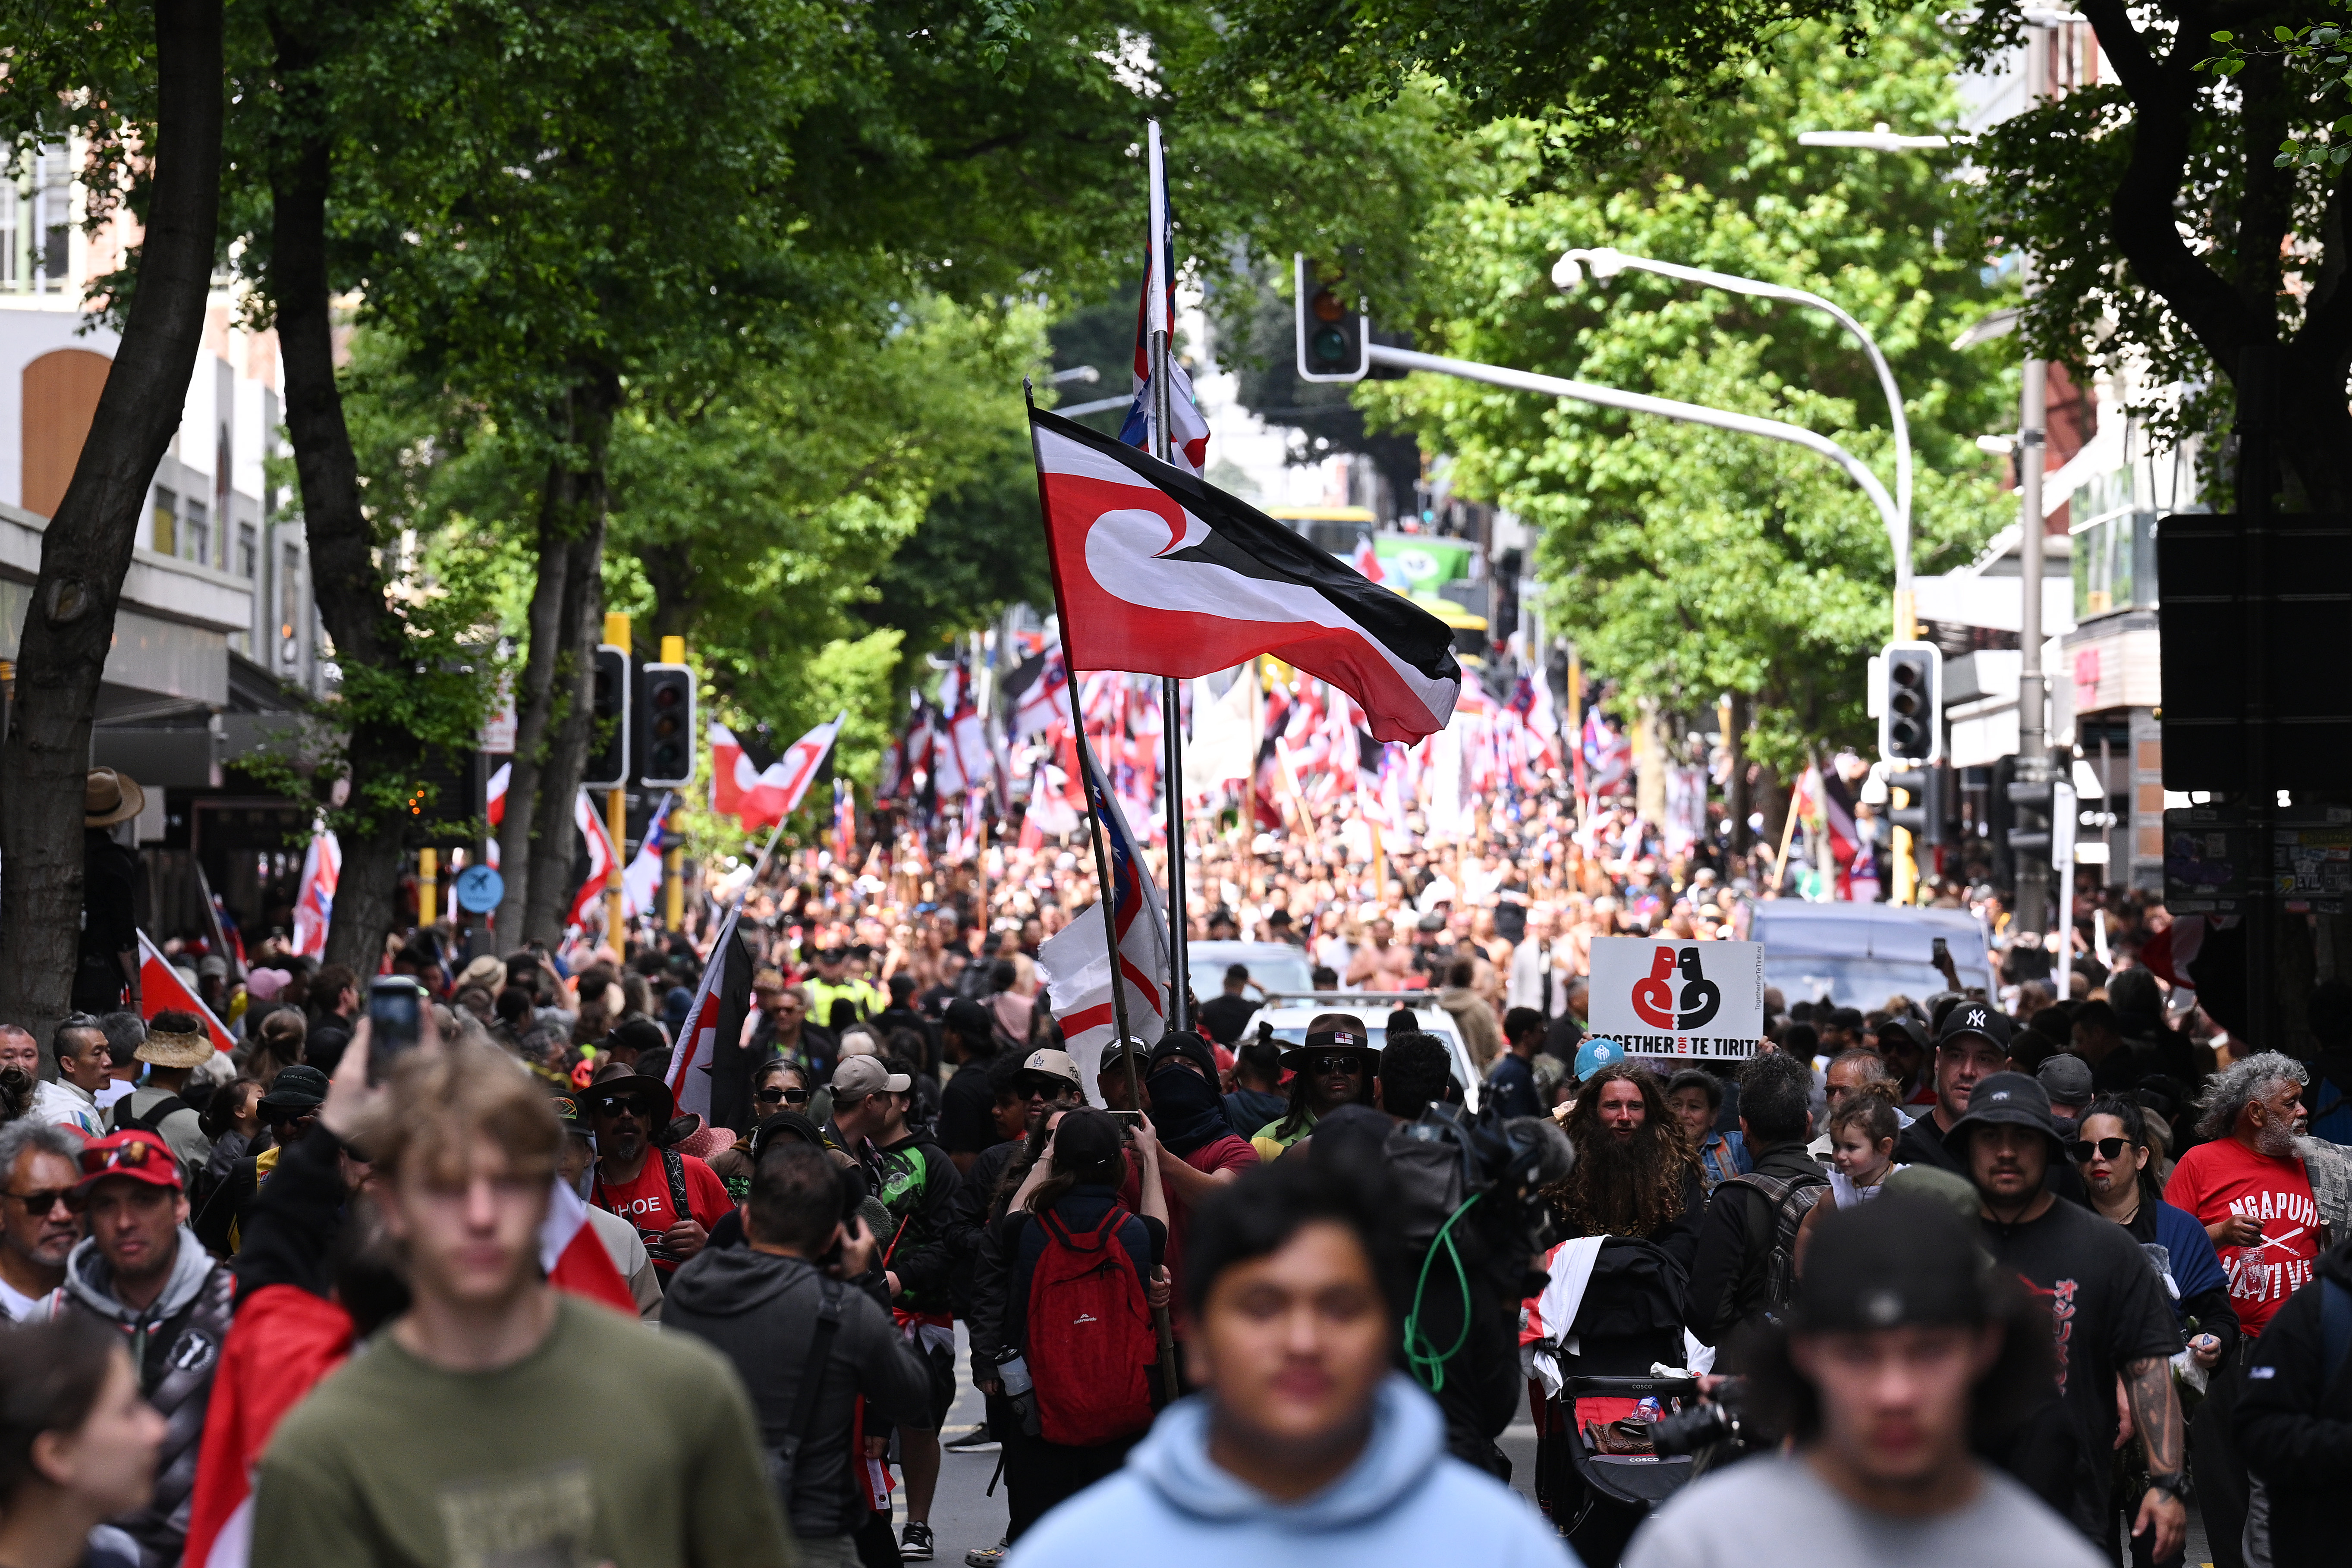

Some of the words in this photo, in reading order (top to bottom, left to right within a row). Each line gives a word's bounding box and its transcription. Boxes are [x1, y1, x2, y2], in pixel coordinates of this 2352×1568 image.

[1965, 1009, 1987, 1027] NY
[1678, 1037, 1687, 1054] FOR
[1691, 1037, 1708, 1055] TE
